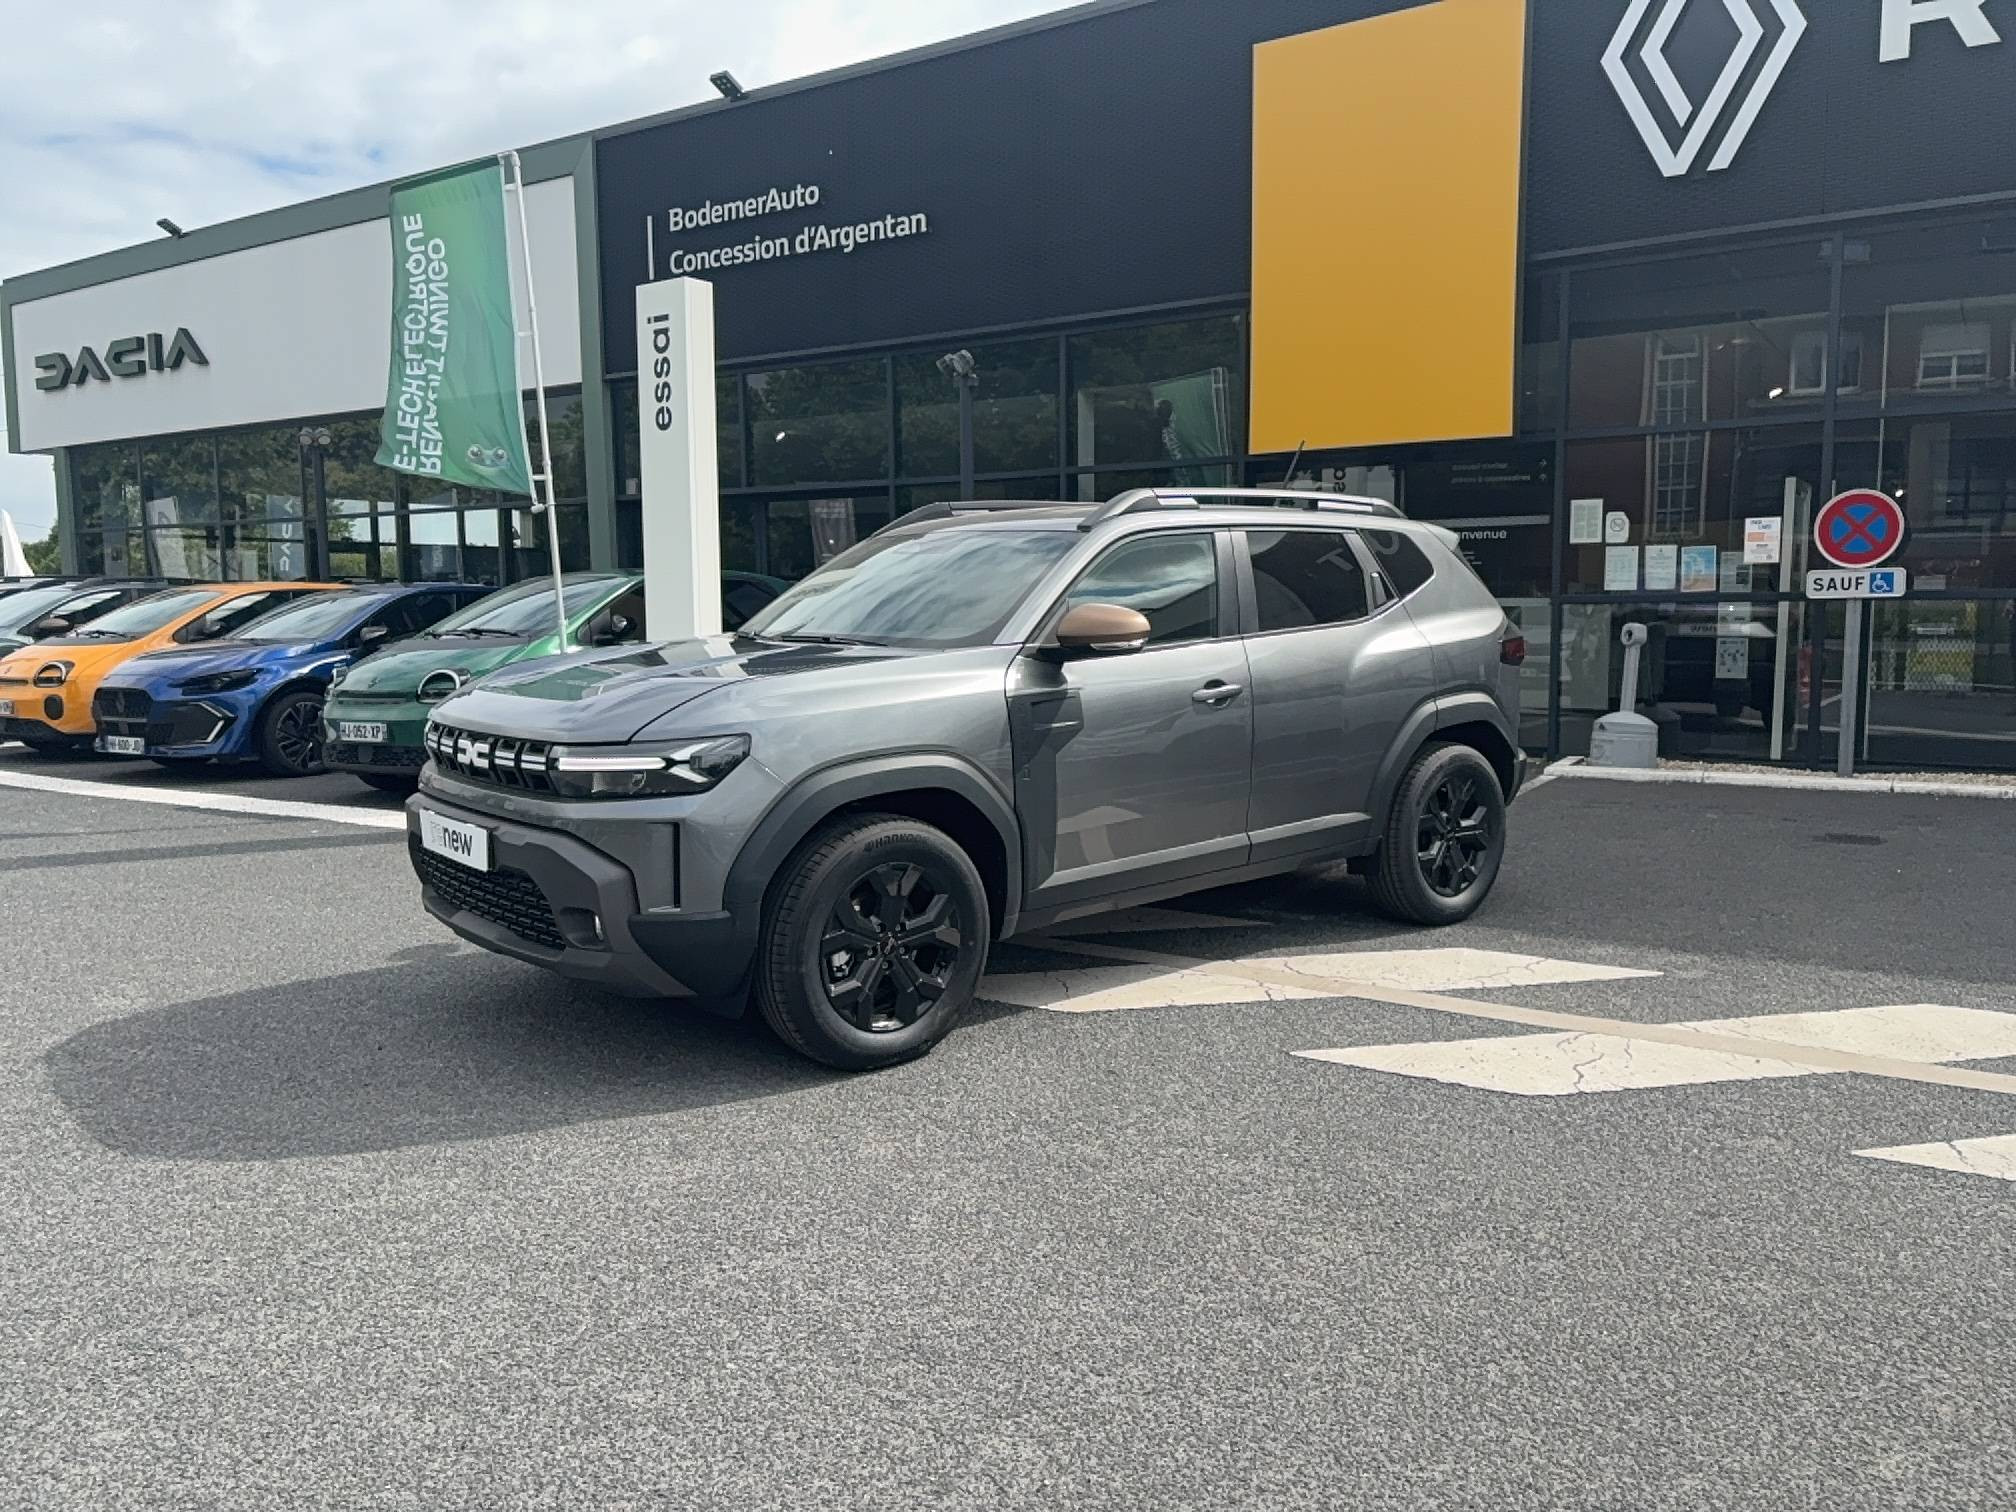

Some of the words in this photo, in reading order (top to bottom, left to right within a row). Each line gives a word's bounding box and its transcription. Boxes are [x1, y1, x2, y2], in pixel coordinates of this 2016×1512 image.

[668, 184, 820, 232] BodemerAuto
[669, 235, 790, 274] Concession
[795, 213, 928, 252] d'Argentan
[34, 327, 209, 391] DACIA
[646, 313, 673, 431] essai
[1461, 530, 1507, 540] nvenue
[1813, 576, 1865, 592] SAUF
